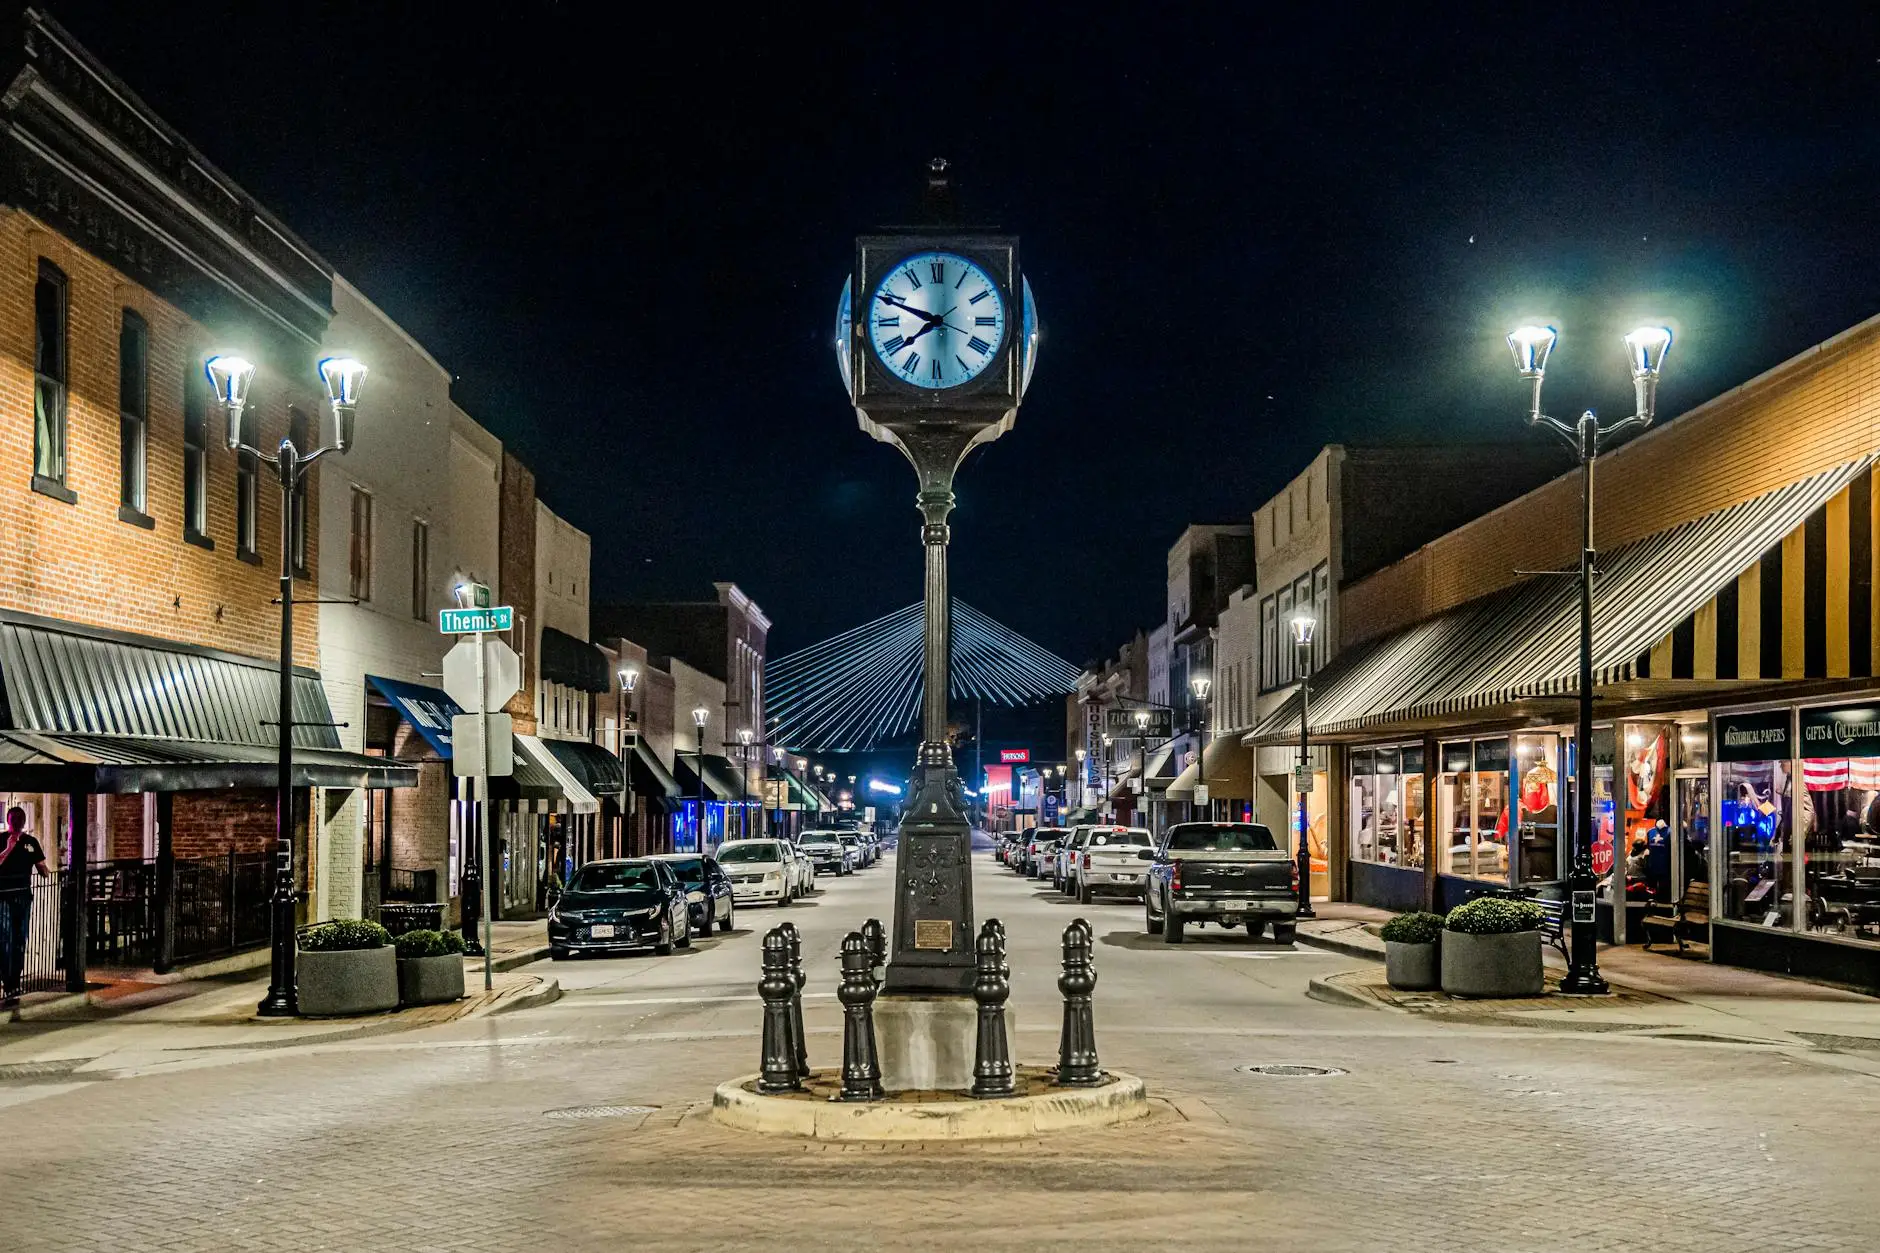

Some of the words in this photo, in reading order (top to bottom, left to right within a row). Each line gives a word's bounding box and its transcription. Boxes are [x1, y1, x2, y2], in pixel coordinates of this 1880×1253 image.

[931, 263, 944, 284] XII
[969, 290, 990, 305] II
[975, 317, 996, 326] III
[445, 611, 497, 631] Themis
[500, 614, 508, 623] St
[1724, 725, 1761, 746] HISTORICAL
[1761, 728, 1786, 745] PAPERS
[1805, 724, 1826, 741] GIFTS
[1827, 726, 1833, 740] &
